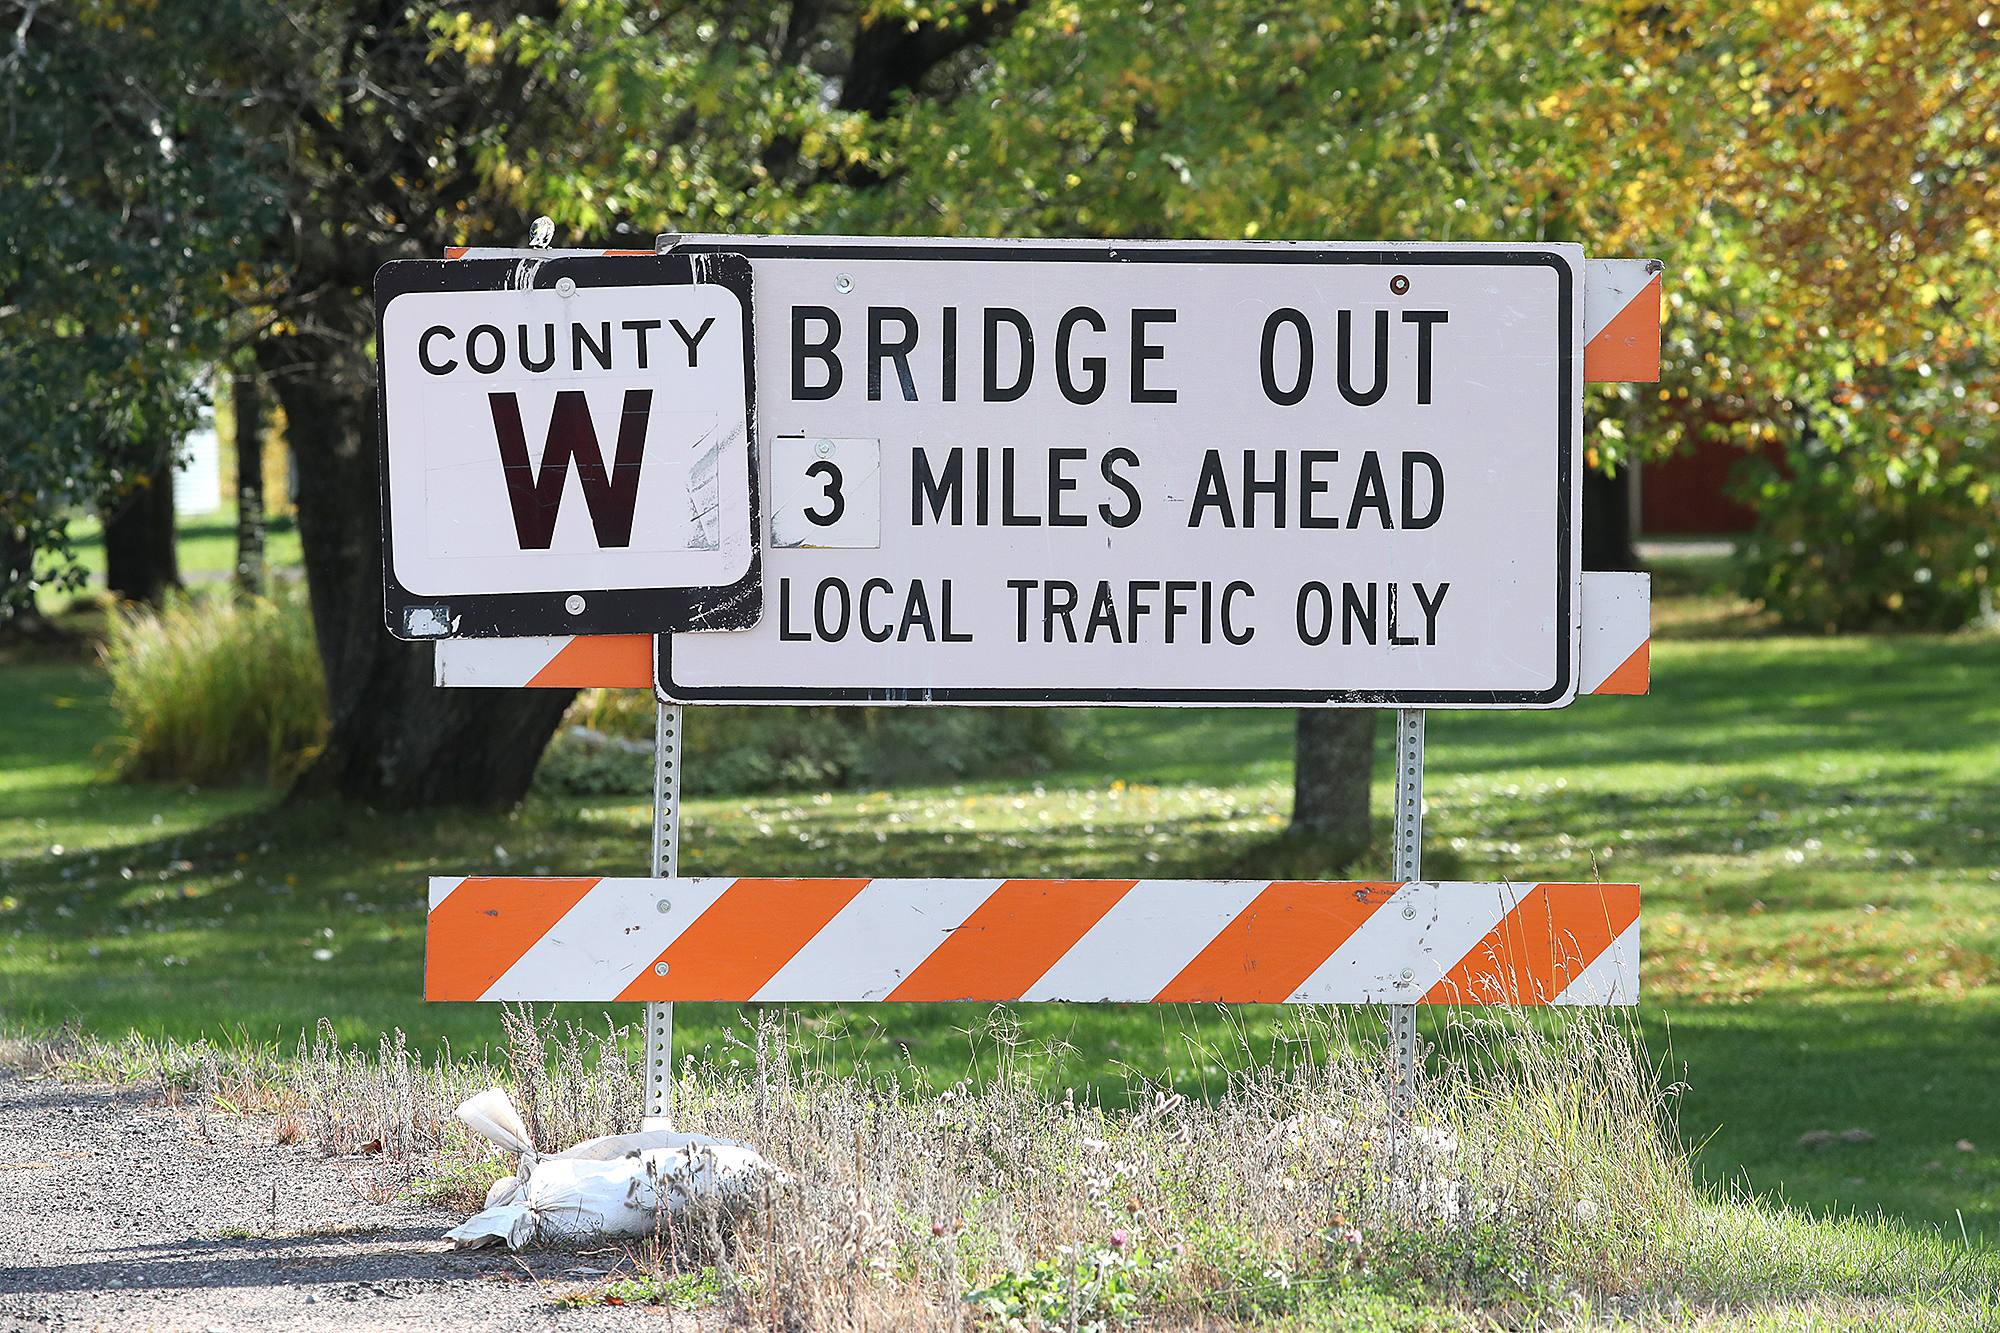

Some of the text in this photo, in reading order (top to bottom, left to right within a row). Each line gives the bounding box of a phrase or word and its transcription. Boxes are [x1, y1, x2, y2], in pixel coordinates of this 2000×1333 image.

[418, 317, 716, 376] COUNTY
[791, 305, 1449, 407] BRIDGE OUT
[487, 388, 654, 550] W
[803, 446, 1445, 530] 3 MILES AHEAD
[779, 576, 1451, 647] LOCAL TRAFFIC ONLY
